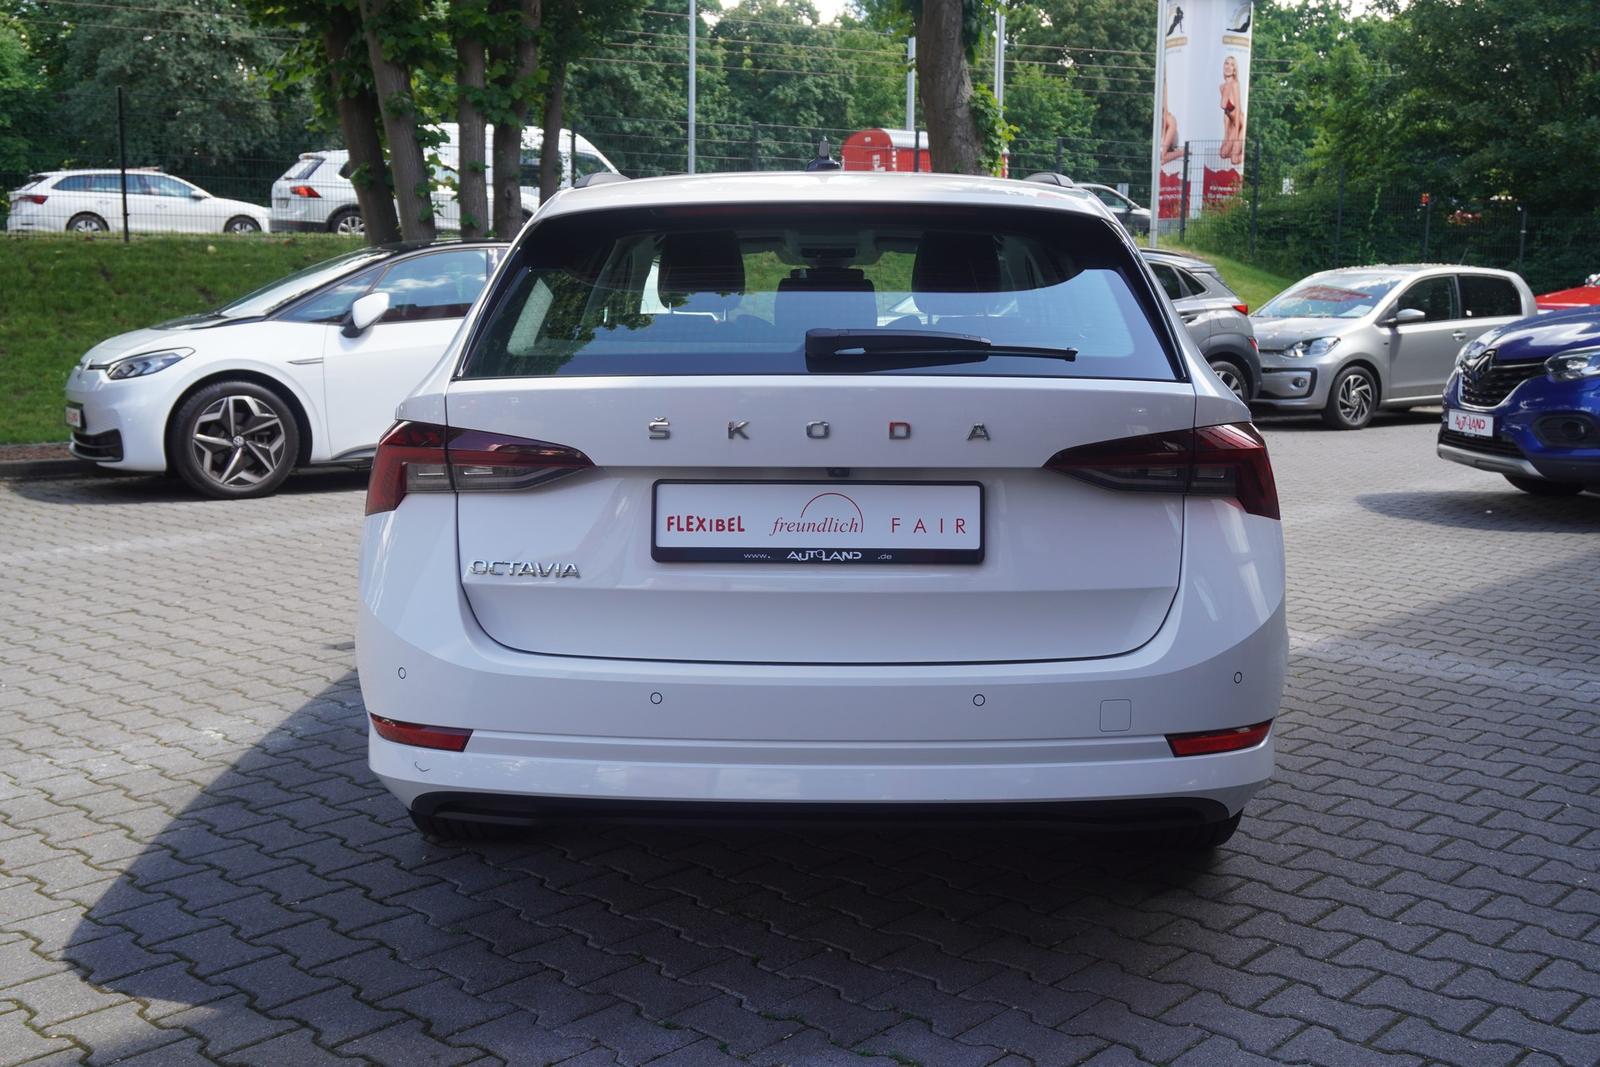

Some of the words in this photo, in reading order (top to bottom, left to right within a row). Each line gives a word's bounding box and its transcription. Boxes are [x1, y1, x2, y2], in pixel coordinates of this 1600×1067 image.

[648, 417, 991, 441] ŠKODA
[666, 514, 745, 533] FLEXIBEL
[768, 516, 859, 537] freundlich
[890, 517, 967, 534] FAIR
[785, 549, 863, 561] AUTOLAND
[470, 559, 581, 579] OCTAVIA
